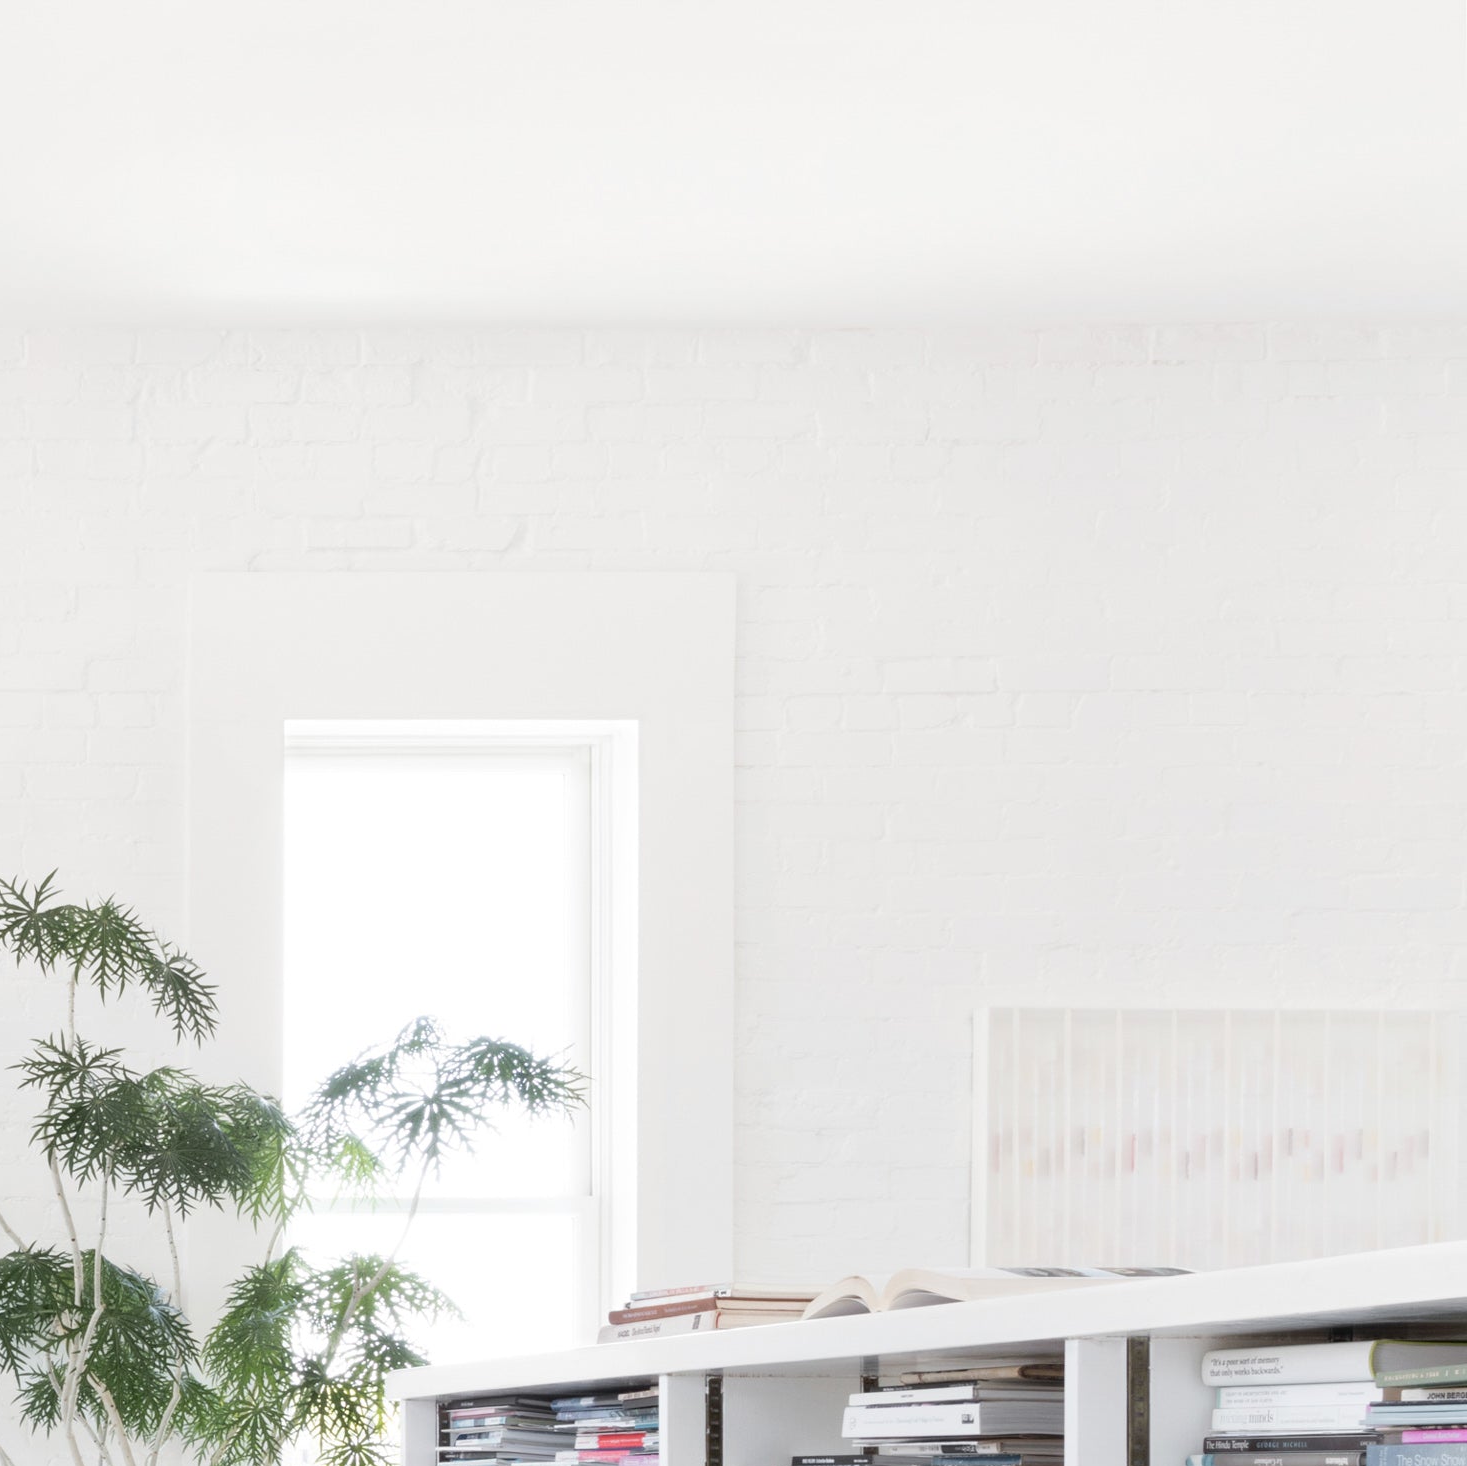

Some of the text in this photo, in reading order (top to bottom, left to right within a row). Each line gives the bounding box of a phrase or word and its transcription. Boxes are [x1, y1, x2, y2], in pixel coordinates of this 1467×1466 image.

[1226, 1358, 1238, 1369] poor
[1238, 1357, 1250, 1366] sort
[1257, 1356, 1280, 1367] memory
[1210, 1368, 1220, 1377] that
[1221, 1367, 1233, 1378] only
[1234, 1366, 1250, 1376] works
[1206, 1440, 1215, 1449] The
[1231, 1439, 1249, 1452] Temple
[1256, 1441, 1280, 1449] GEORGE
[1396, 1454, 1412, 1466] The
[1414, 1454, 1438, 1466] Snow
